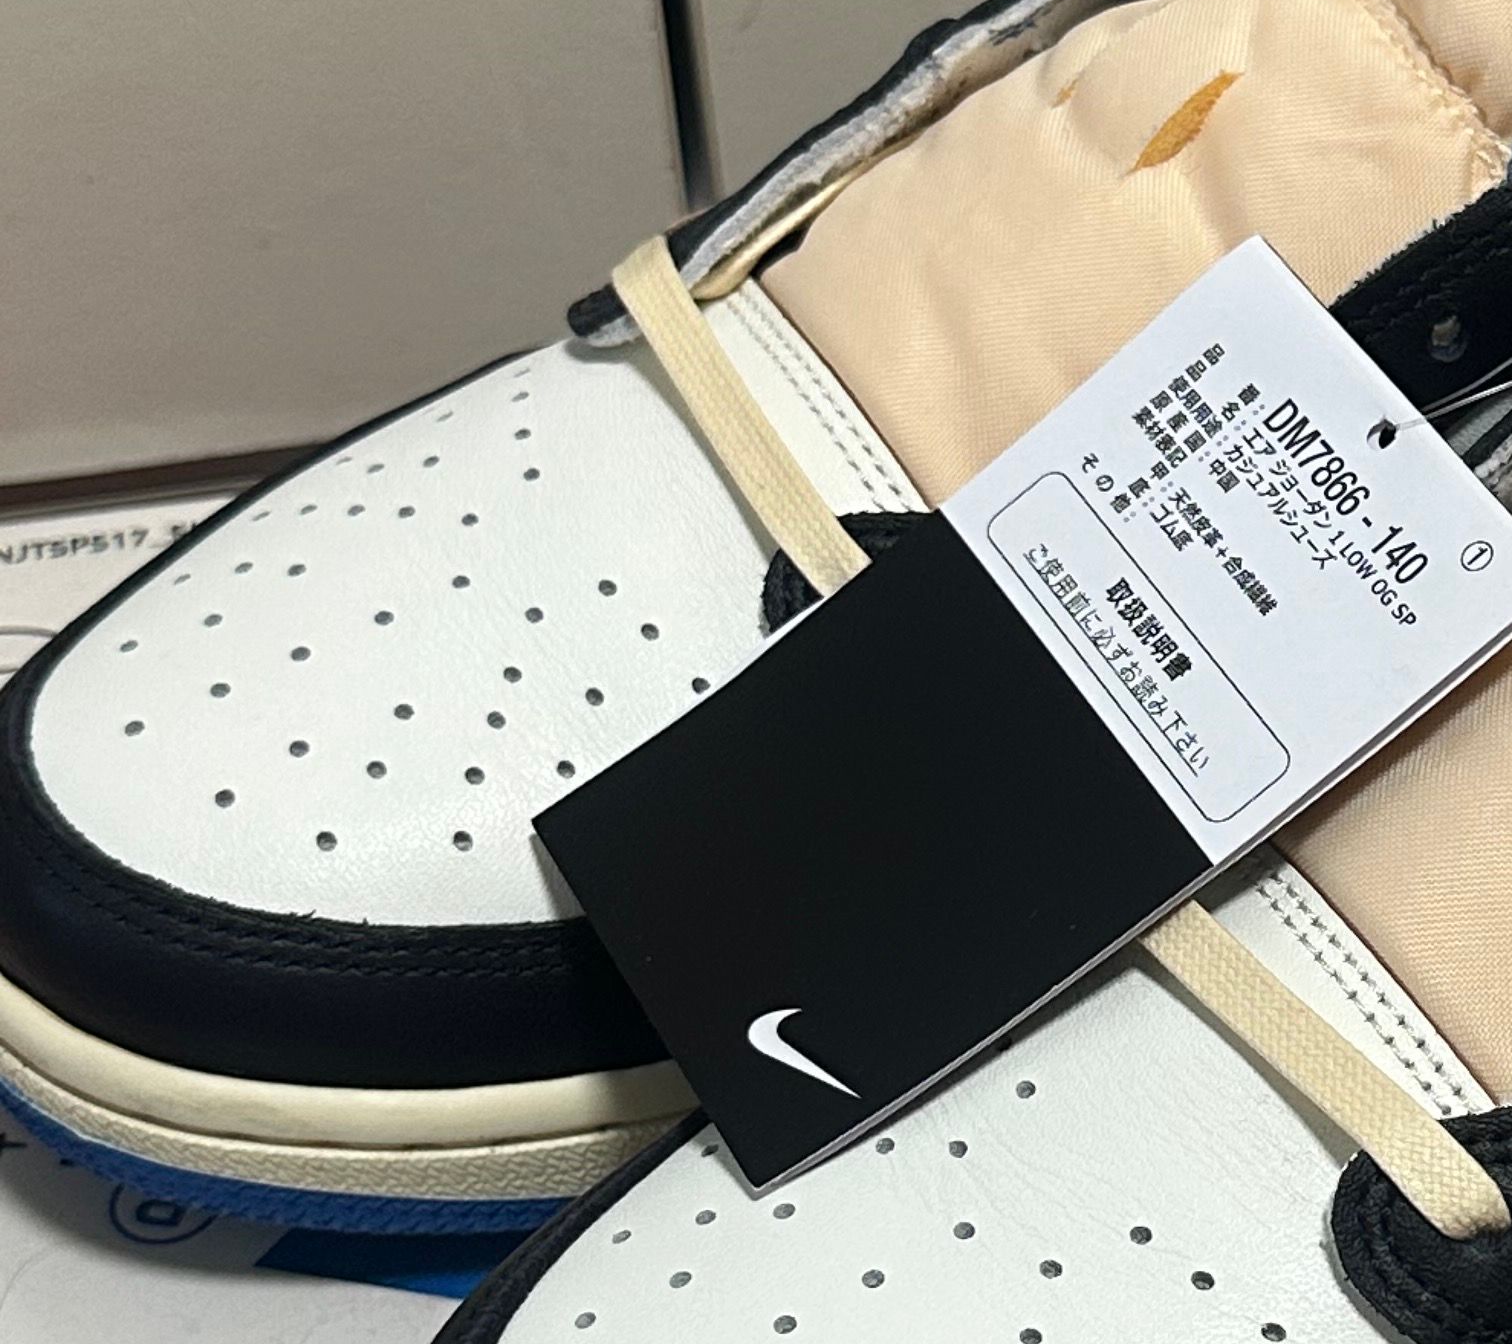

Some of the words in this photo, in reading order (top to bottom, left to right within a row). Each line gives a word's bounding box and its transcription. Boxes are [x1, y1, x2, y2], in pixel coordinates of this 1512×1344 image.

[1209, 459, 1240, 492] 中国
[1262, 398, 1370, 515] DM7866
[1371, 526, 1428, 584] 140
[1105, 577, 1192, 681] 取扱説明書
[1328, 530, 1344, 545] 1
[1339, 542, 1378, 579] LOW
[1371, 579, 1398, 605] OG
[1391, 603, 1416, 625] SP
[1026, 543, 1209, 770] ご使用前に必ずお読み下さい
